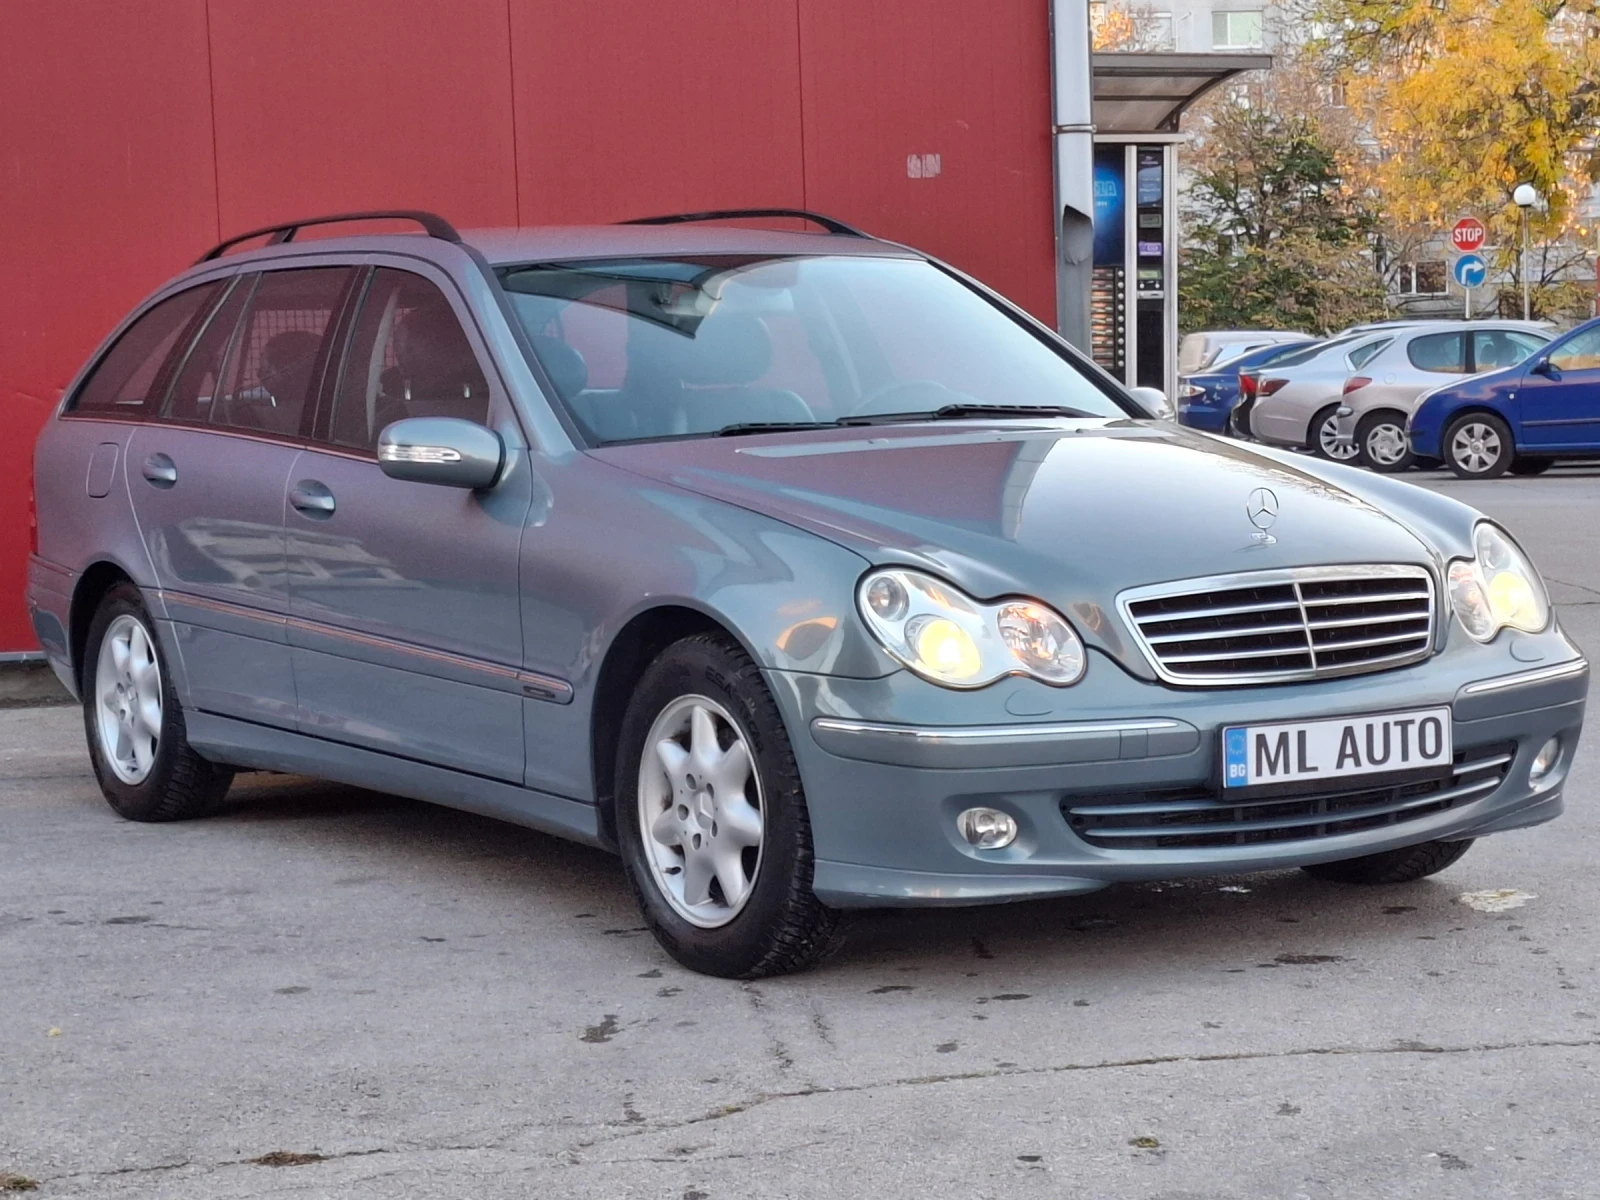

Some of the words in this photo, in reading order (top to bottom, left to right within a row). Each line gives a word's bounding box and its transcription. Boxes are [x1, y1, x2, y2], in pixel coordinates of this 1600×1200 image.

[1454, 228, 1482, 242] STOP
[1255, 730, 1319, 777] ML
[1336, 717, 1442, 769] AUTO
[1230, 764, 1245, 778] BG
